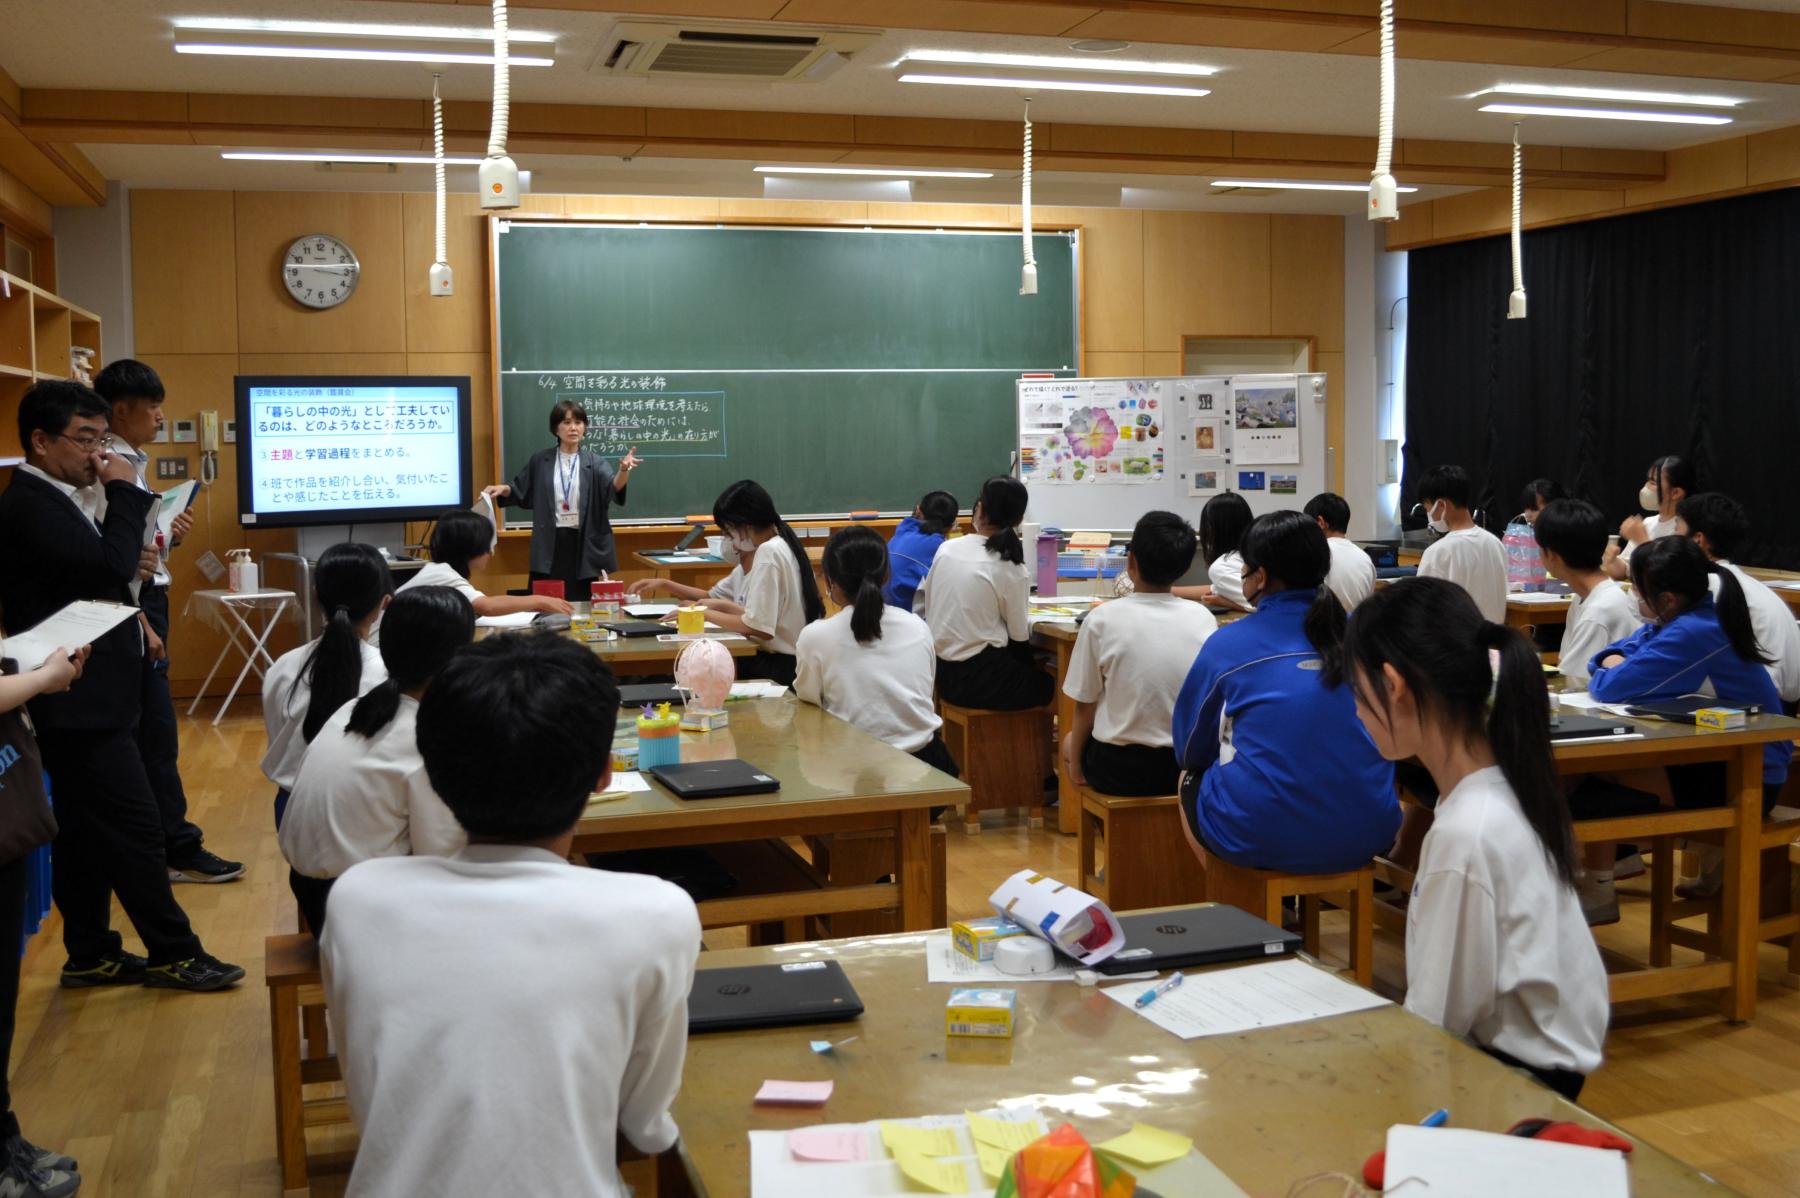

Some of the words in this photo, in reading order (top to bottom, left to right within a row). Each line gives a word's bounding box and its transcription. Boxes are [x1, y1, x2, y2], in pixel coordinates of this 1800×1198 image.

[303, 247, 311, 255] 11
[315, 243, 325, 251] 12
[294, 256, 303, 264] 10
[339, 255, 345, 263] 2
[292, 268, 298, 276] 9
[343, 268, 350, 276] 3
[296, 280, 303, 288] 8
[306, 288, 312, 296] 7
[318, 291, 324, 299] 6
[331, 288, 337, 296] 5
[538, 374, 558, 390] 6/4
